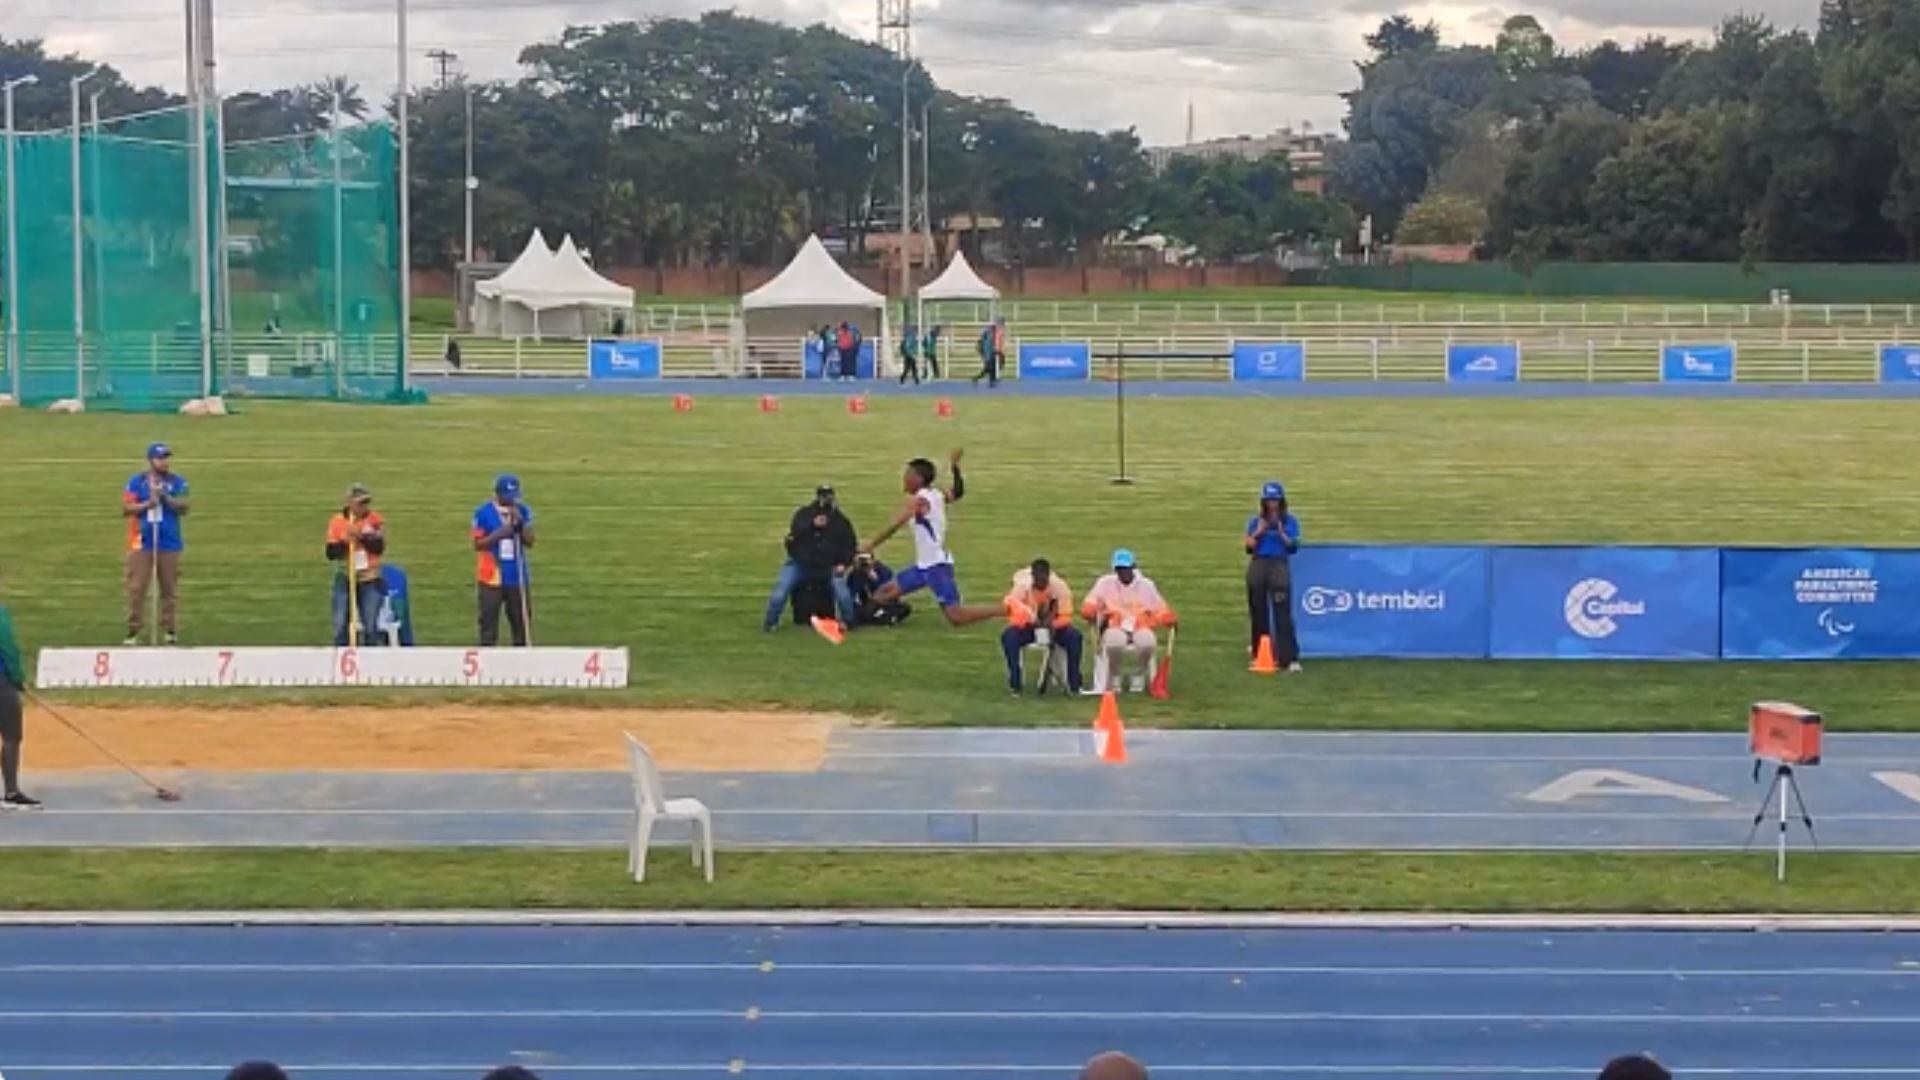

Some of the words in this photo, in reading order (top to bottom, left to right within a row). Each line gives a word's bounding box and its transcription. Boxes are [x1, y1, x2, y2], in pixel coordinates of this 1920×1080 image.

[1794, 580, 1879, 590] PARALYMPIC
[1357, 590, 1445, 609] tembici
[1796, 591, 1876, 603] COMMITTEE
[94, 651, 110, 677] 8
[218, 651, 233, 676] 7
[340, 650, 357, 677] 6
[463, 651, 479, 676] 5
[584, 652, 600, 676] 4
